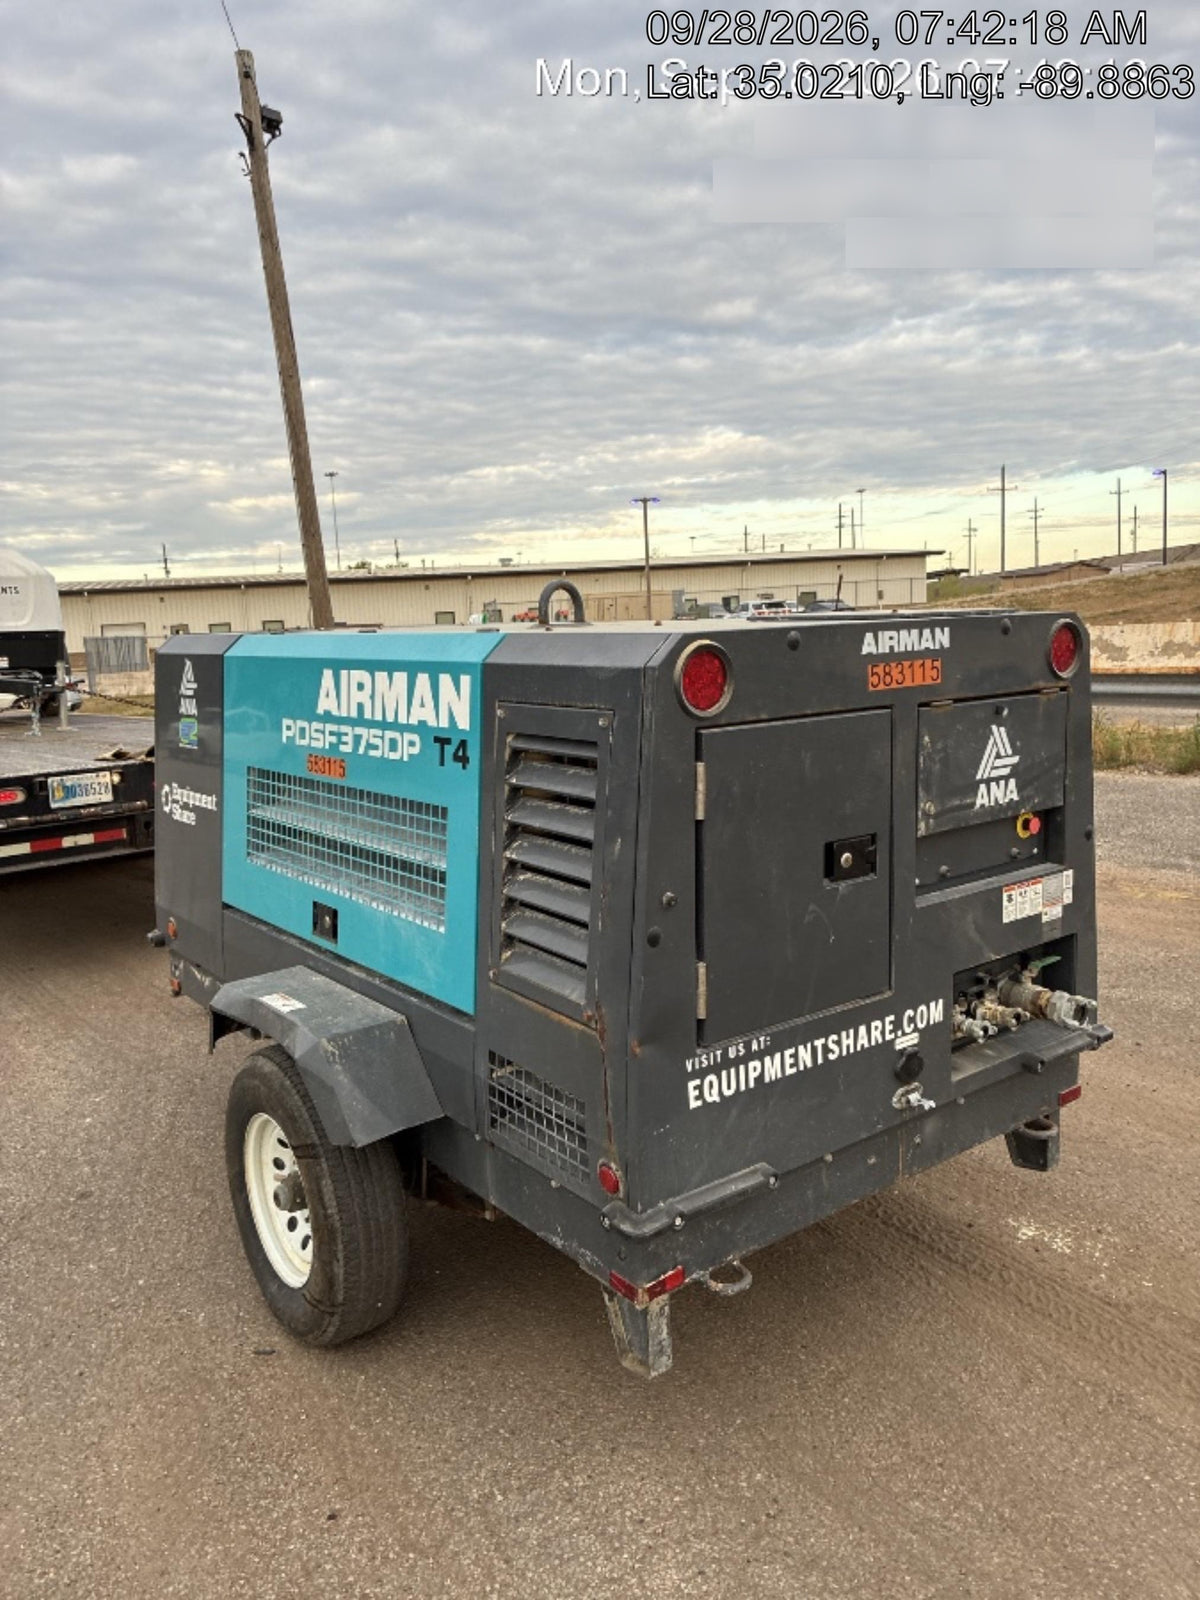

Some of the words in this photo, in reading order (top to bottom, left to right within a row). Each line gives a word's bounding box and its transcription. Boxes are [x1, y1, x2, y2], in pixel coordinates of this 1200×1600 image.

[860, 626, 951, 655] AIRMAN
[870, 658, 940, 689] 583115
[316, 668, 472, 731] AIRMAN
[433, 735, 471, 770] T4
[975, 778, 1020, 810] ANA
[685, 1049, 723, 1073] VISIT
[728, 1042, 746, 1060] US
[751, 1035, 771, 1053] AT:
[687, 998, 944, 1111] EQUIPMENTSHARE.COM
